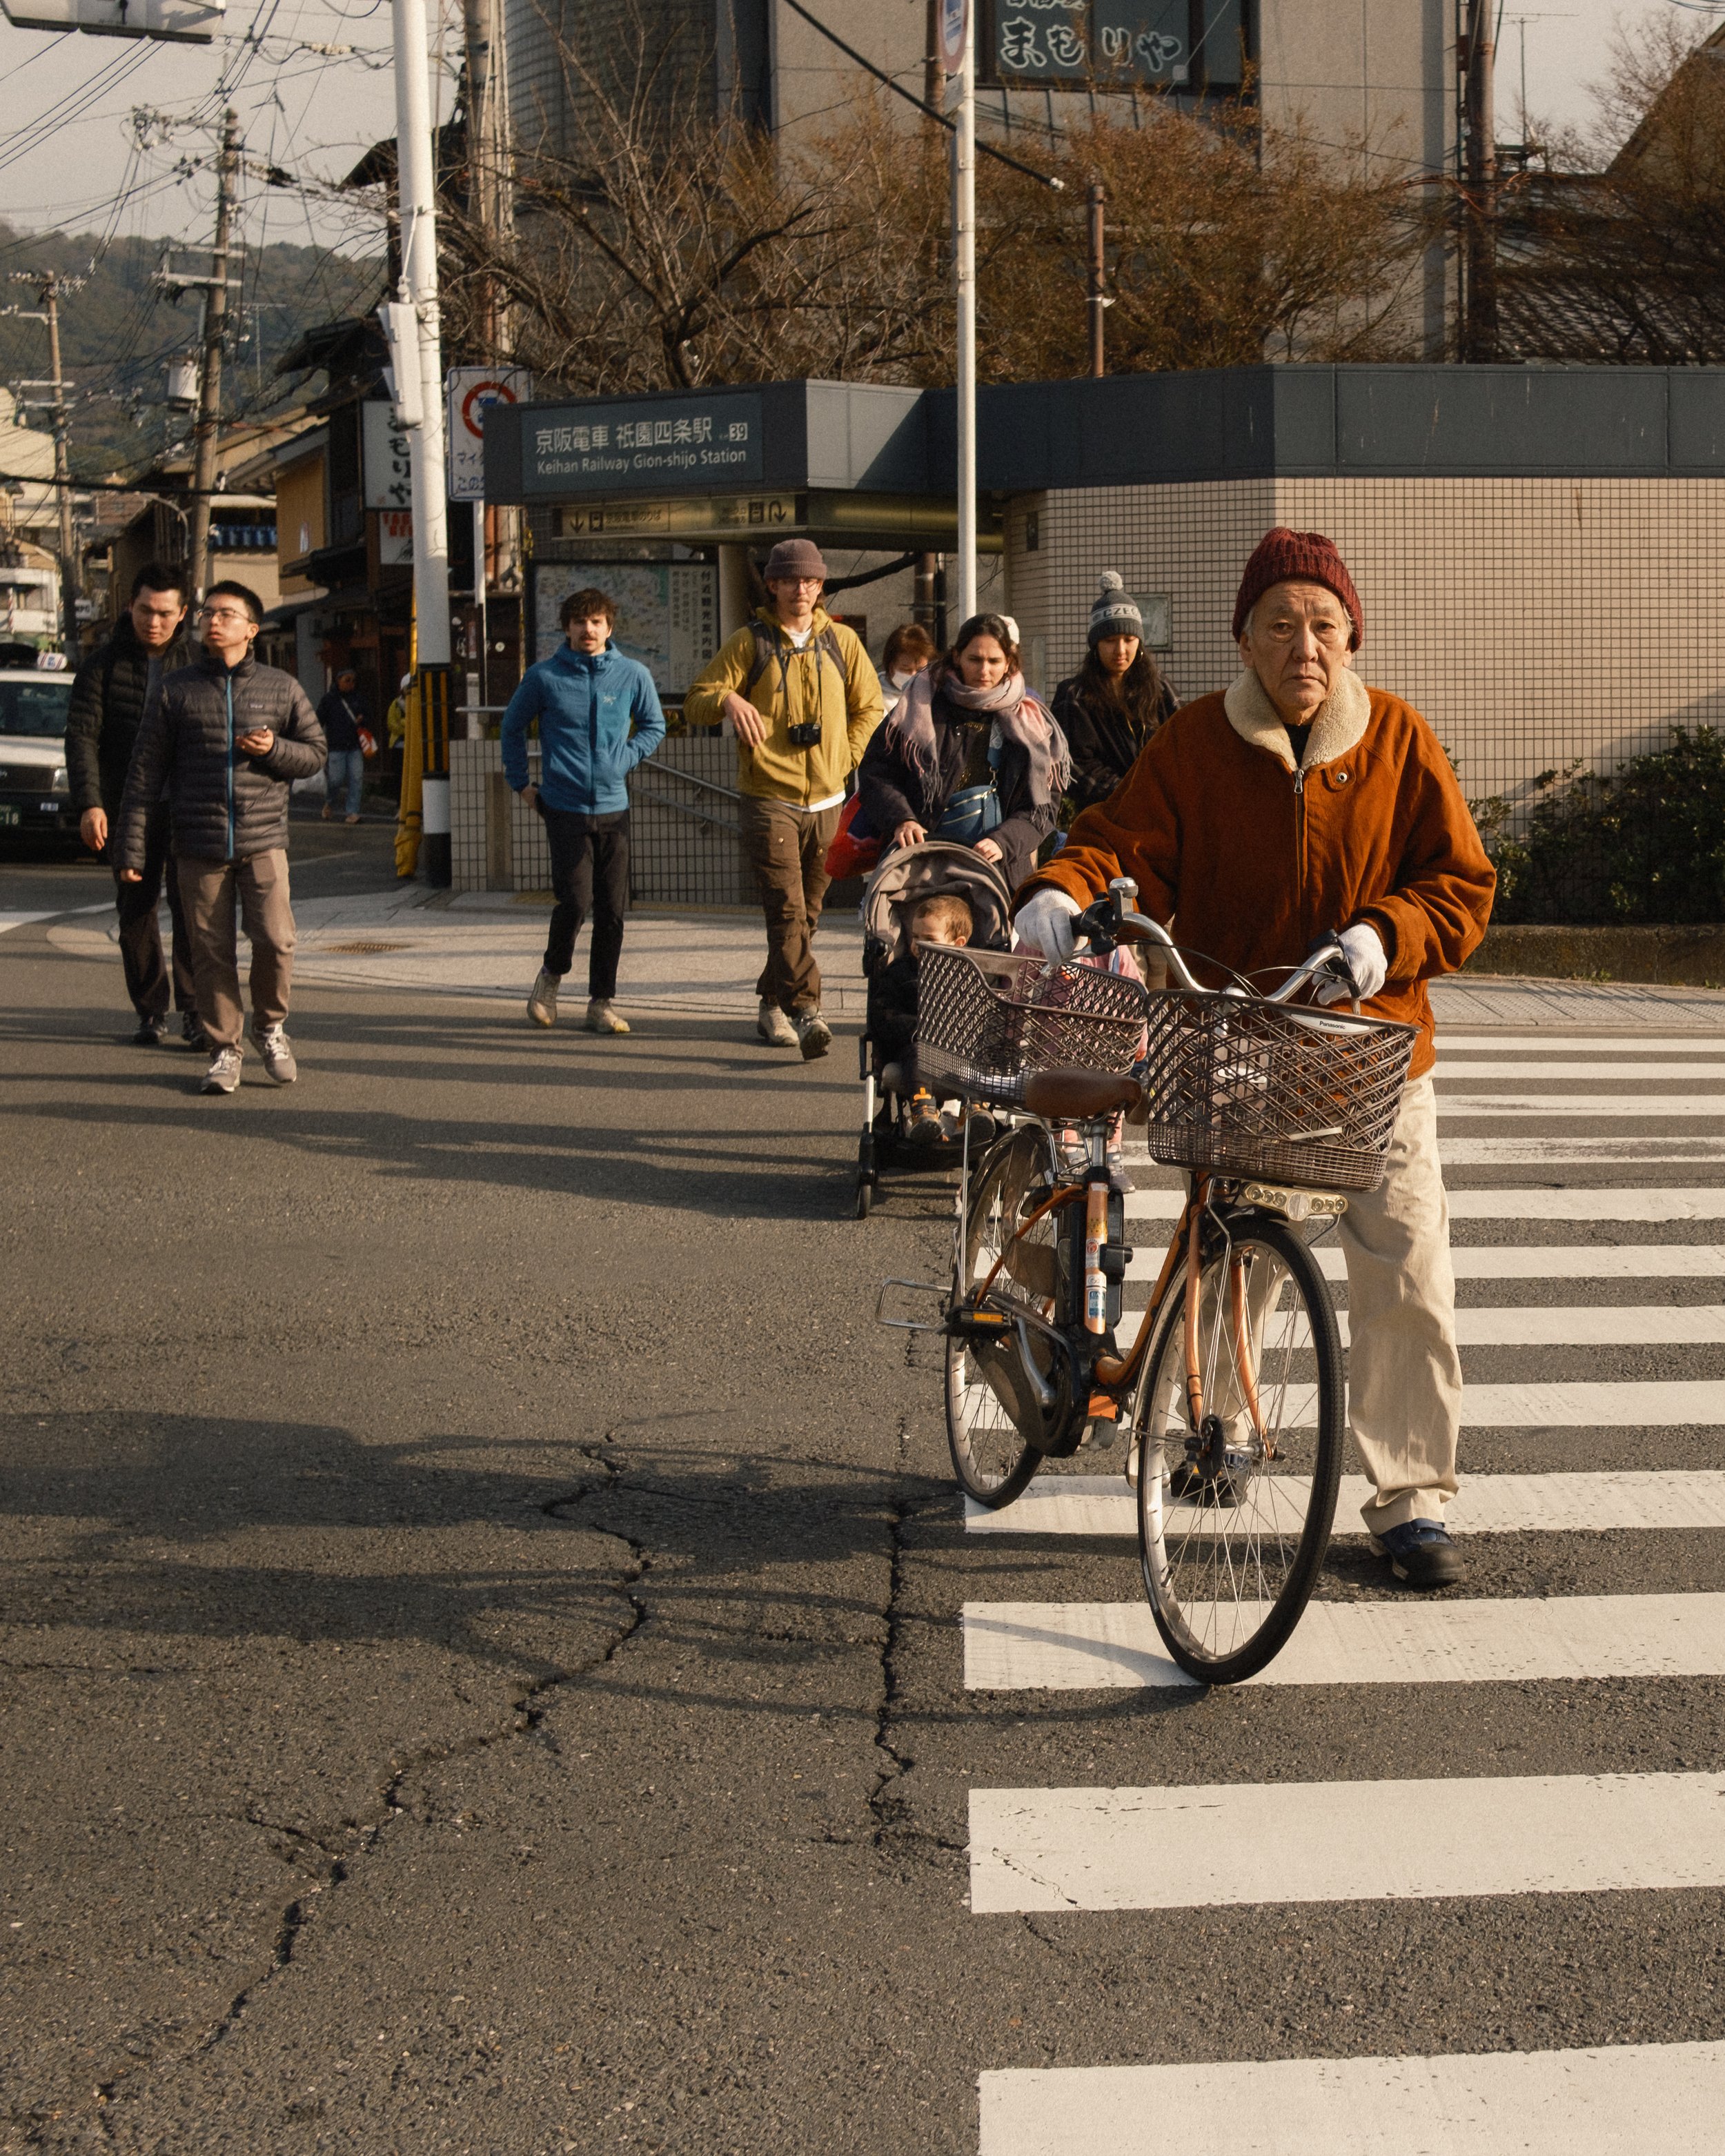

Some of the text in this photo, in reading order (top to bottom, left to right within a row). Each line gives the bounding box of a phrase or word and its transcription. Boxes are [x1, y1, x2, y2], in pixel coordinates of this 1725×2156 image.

[1000, 17, 1181, 72] まもりや
[535, 417, 746, 455] 京阪電車 祇園四条駅 39
[537, 447, 746, 475] Keihan Railway Gion-shijo Station
[1319, 1020, 1346, 1030] Panasonic
